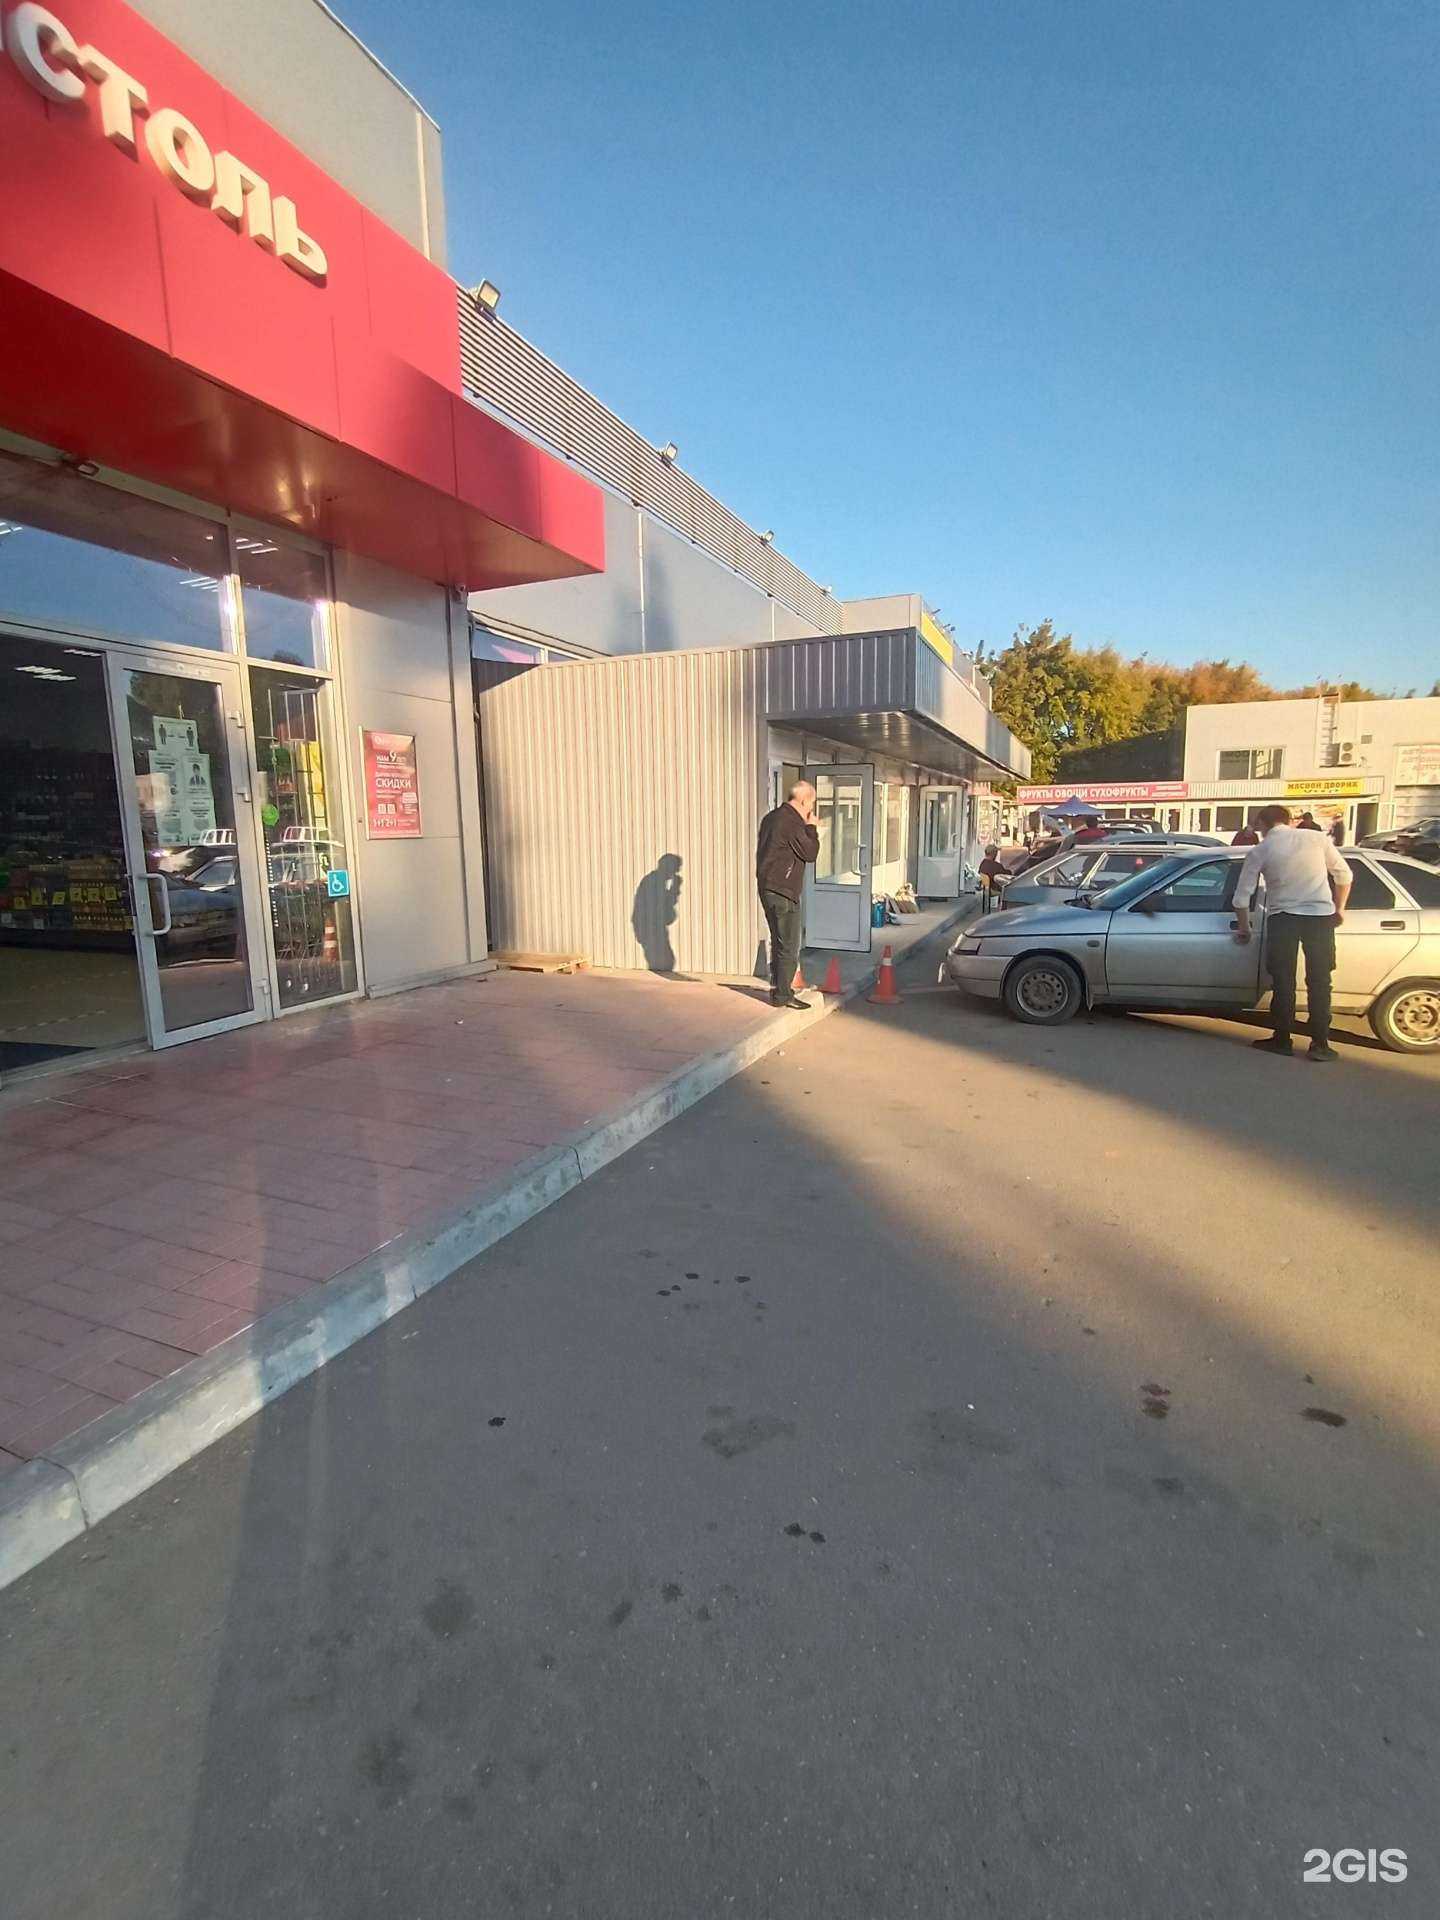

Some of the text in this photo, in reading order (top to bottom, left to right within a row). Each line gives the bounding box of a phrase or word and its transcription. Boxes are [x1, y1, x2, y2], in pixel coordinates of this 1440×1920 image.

[1019, 789, 1052, 799] ФРУКТЫ
[1054, 788, 1088, 799] ОВОЩИ
[1089, 786, 1149, 798] СУХОФРУКТЫ
